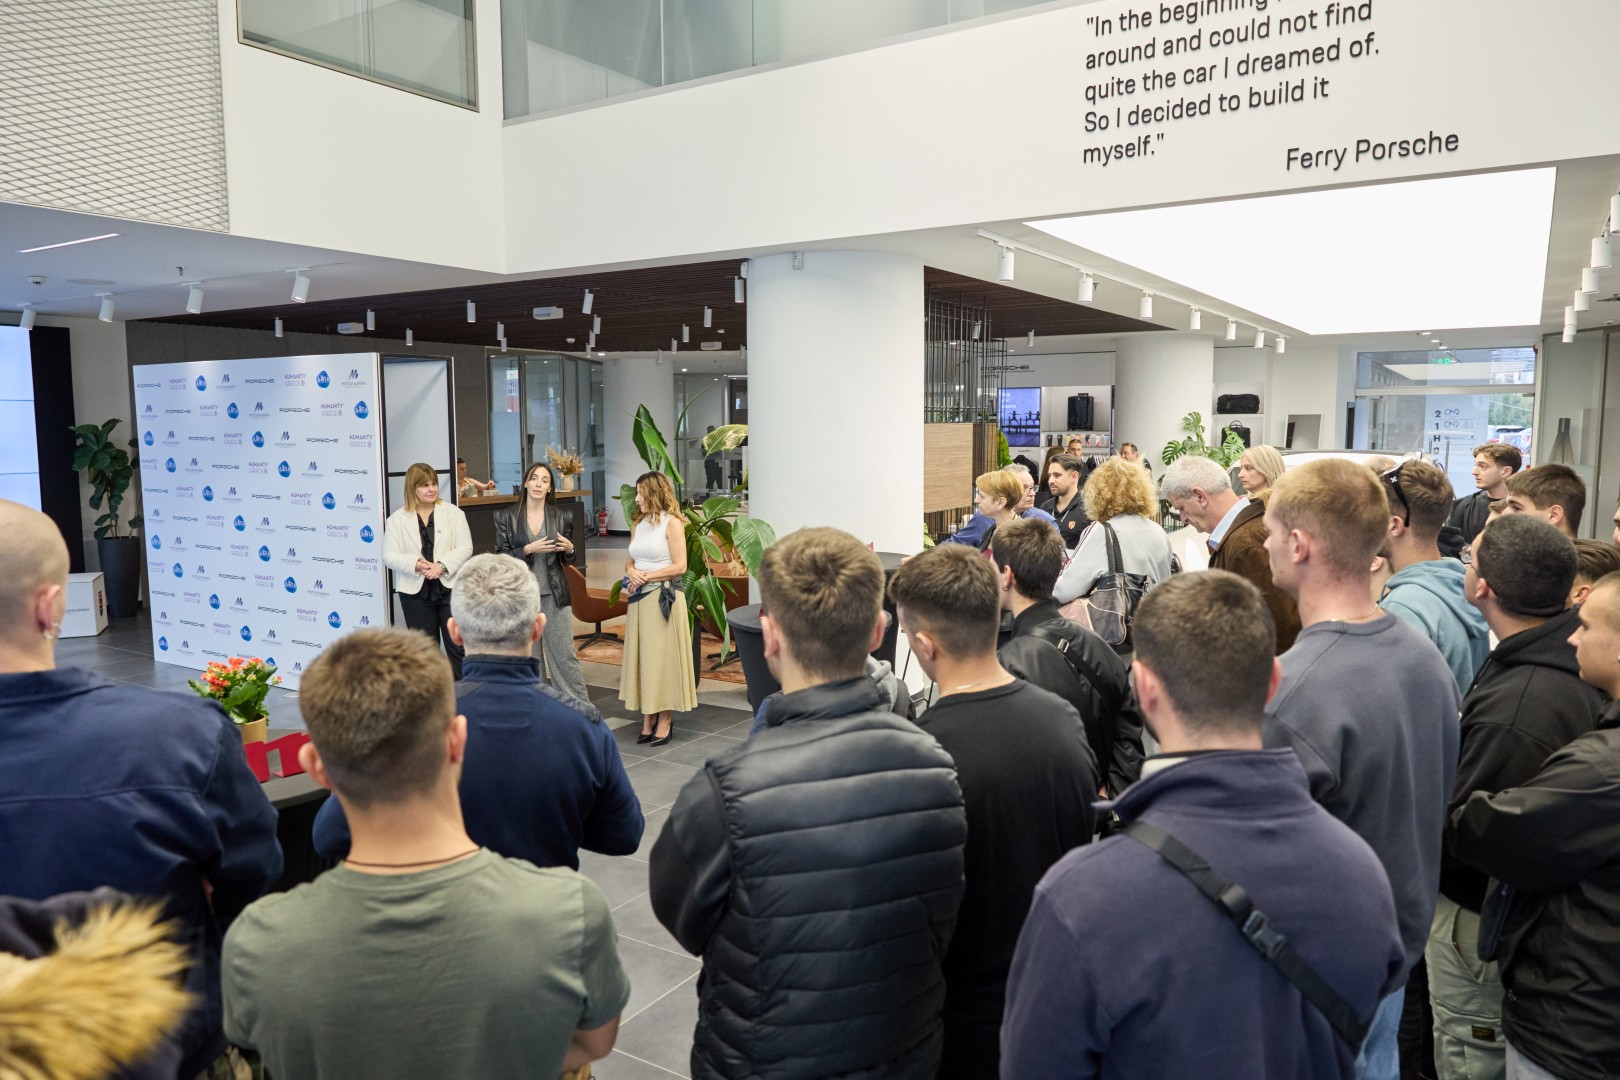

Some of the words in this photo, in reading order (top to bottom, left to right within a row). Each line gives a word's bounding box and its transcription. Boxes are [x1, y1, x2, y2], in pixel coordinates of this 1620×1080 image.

[1085, 37, 1156, 70] around
[1162, 28, 1202, 56] and
[1209, 16, 1270, 48] could
[1279, 9, 1318, 36] not
[1325, 0, 1372, 27] find
[1086, 16, 1112, 37] "In
[1119, 9, 1153, 31] the
[1085, 76, 1136, 106] quite
[1142, 69, 1176, 92] the
[1183, 64, 1217, 85] car
[1224, 56, 1229, 79] I
[1236, 37, 1341, 77] dreamed
[1349, 31, 1380, 58] of.
[1084, 111, 1110, 133] So
[1116, 107, 1121, 128] I
[1127, 93, 1211, 126] decided
[1218, 93, 1241, 113] to
[1248, 78, 1305, 109] build
[1313, 77, 1330, 99] it
[1083, 132, 1165, 167] myself."
[1286, 147, 1348, 172] Ferry
[1355, 130, 1459, 163] Porsche
[312, 556, 344, 564] PORSCHE
[340, 589, 374, 598] PORSCHE
[257, 606, 287, 614] PORSCHE
[291, 640, 322, 648] PORSCHE
